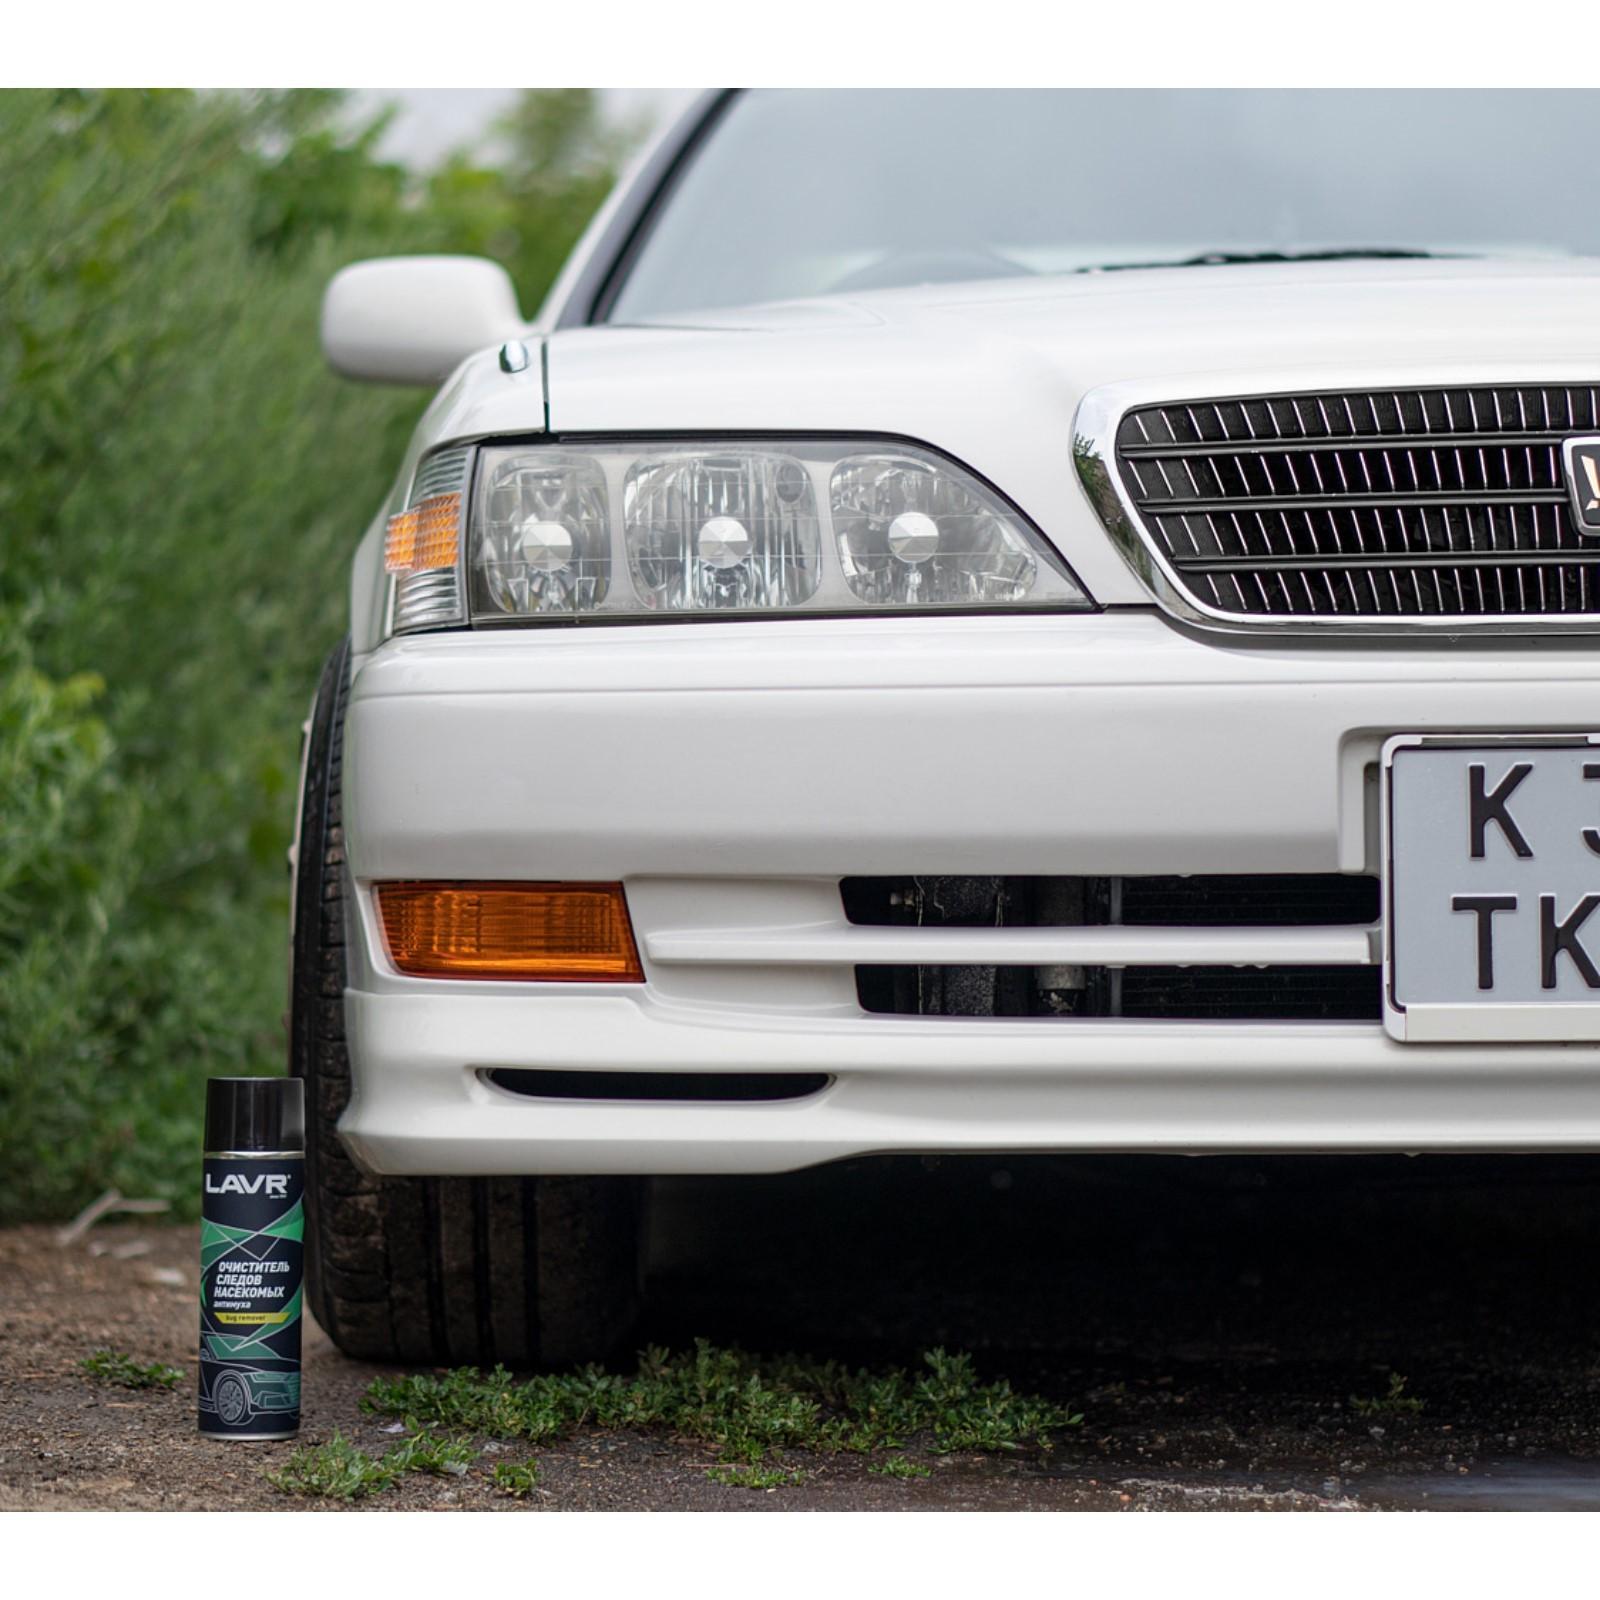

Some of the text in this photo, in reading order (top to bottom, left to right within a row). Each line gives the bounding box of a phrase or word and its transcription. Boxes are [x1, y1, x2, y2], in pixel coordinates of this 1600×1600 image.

[1468, 764, 1534, 858] K
[205, 1173, 288, 1194] LAVR
[218, 1261, 290, 1273] ОЧИСТИТЕЛЬ
[216, 1274, 263, 1287] СЛЕДОВ
[213, 1286, 285, 1298] НАСЕКОМЫХ
